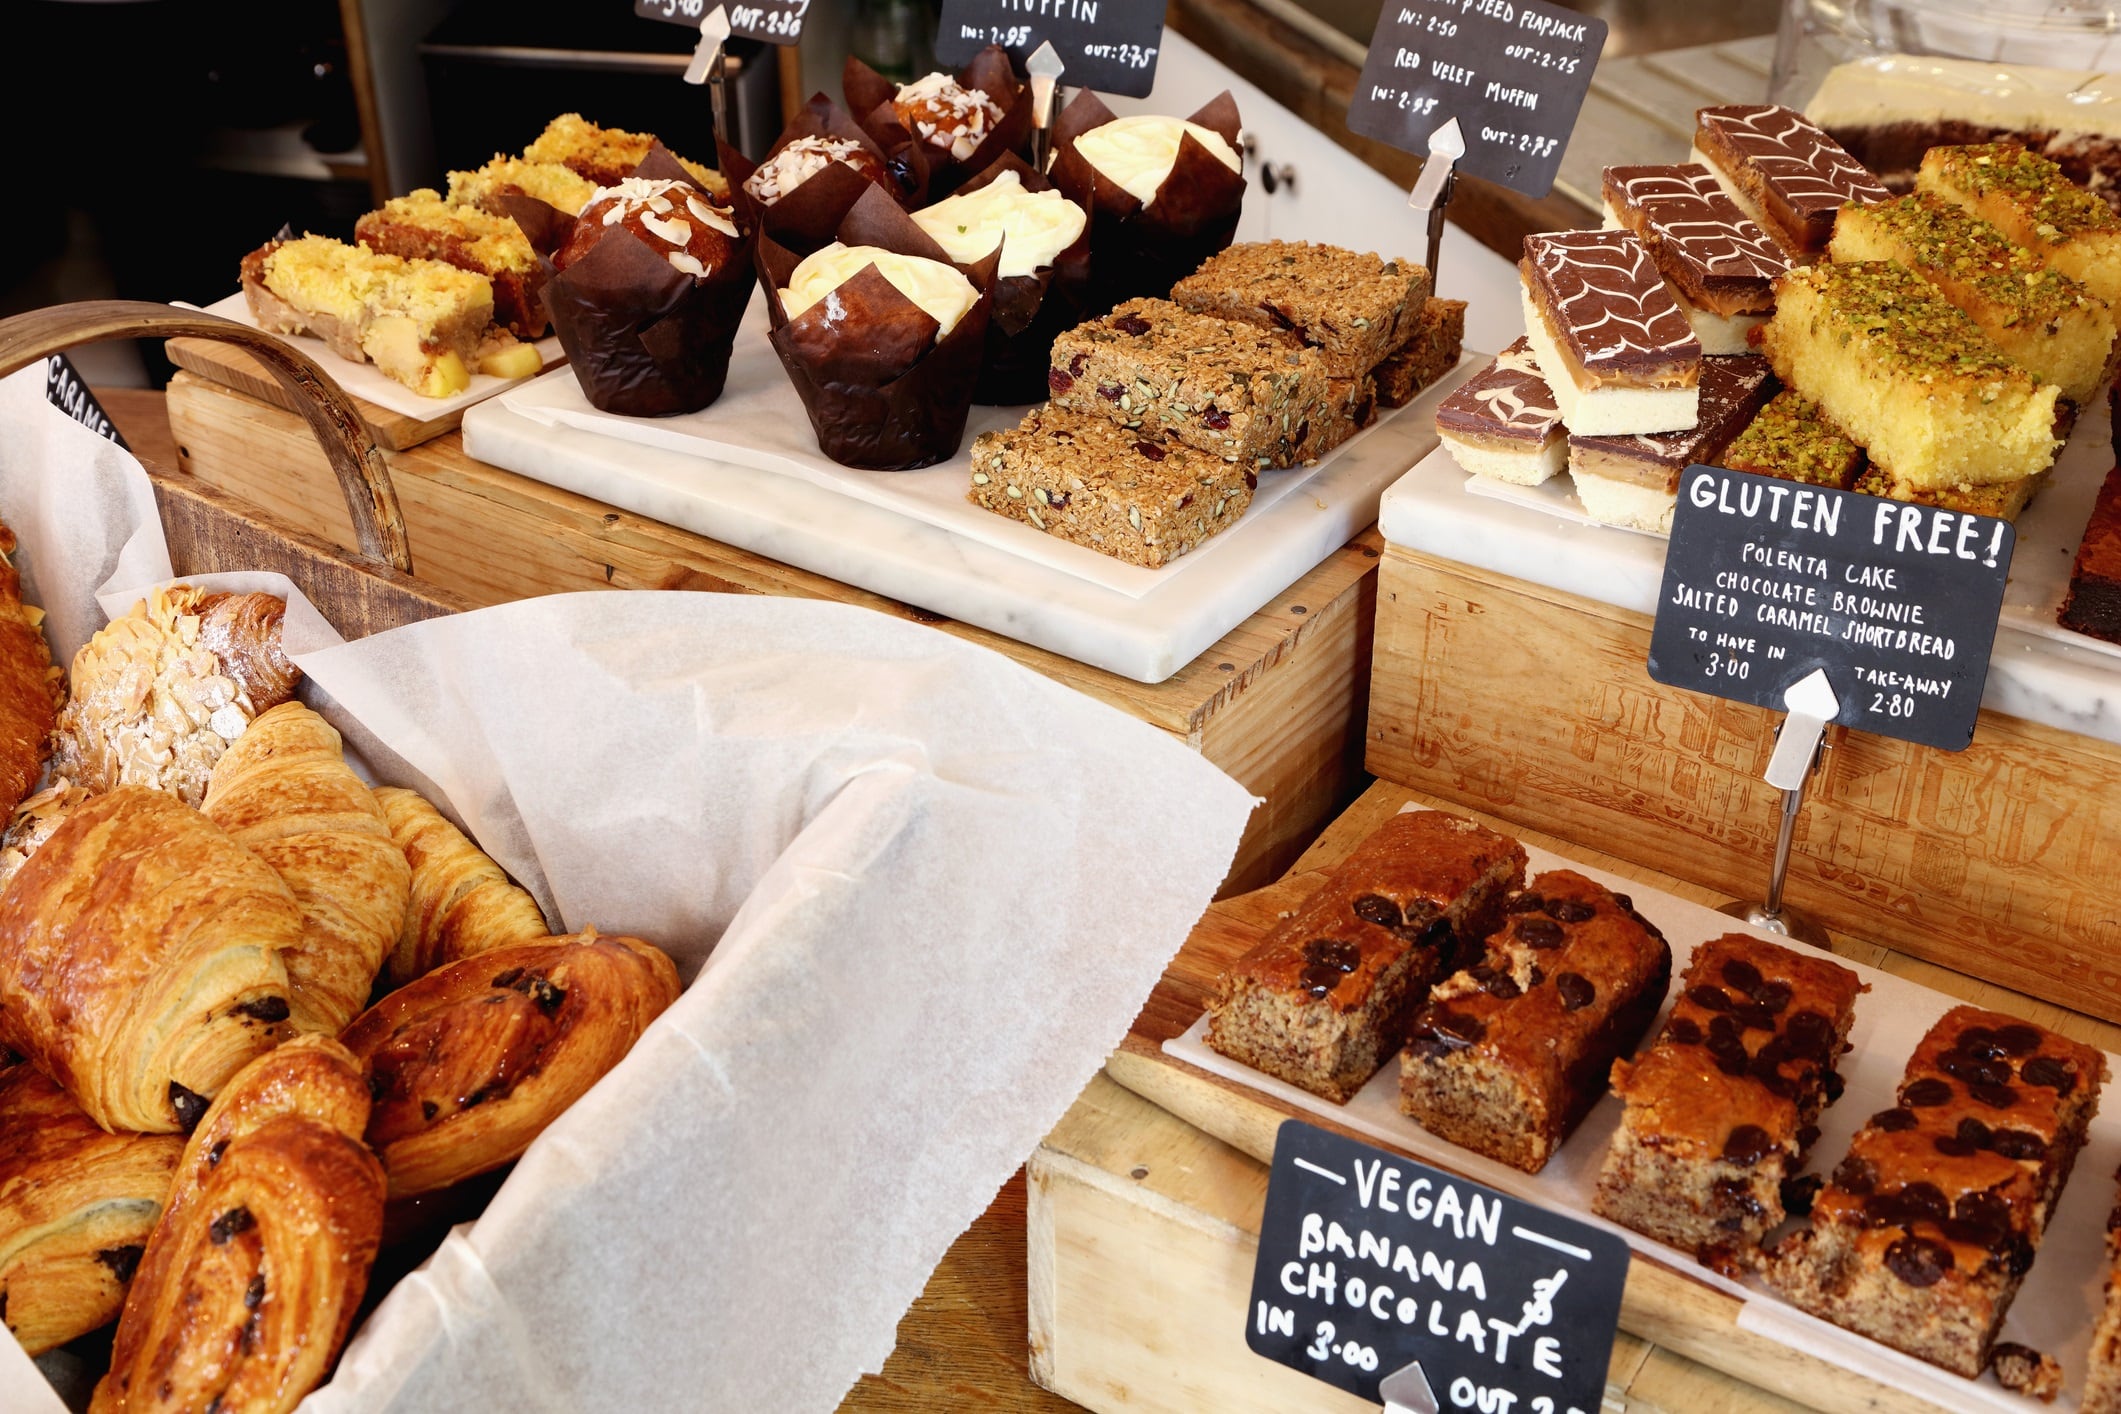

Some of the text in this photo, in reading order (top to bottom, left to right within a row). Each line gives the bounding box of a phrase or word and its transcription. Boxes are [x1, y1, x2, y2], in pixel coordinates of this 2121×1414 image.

[1519, 10, 1587, 42] FLAPJACK
[1394, 47, 1539, 111] RED VELET MUFFIN
[1690, 474, 2005, 568] GLUTEN FREE!
[1742, 543, 1898, 590] POLENTA CAKE
[1672, 583, 1955, 660] SALTED CARAMEL SHORTBREAD
[1716, 572, 1925, 625] CHOCOLATE BROWNIE
[1688, 627, 1786, 660] TO HAVE IN
[1855, 666, 1952, 699] TAKE-AWAY
[1815, 861, 1923, 918] VEGA
[1354, 1159, 1503, 1246] VEGAN
[1299, 1213, 1487, 1301] BANANA
[1256, 1300, 1296, 1337] IN
[1280, 1261, 1564, 1379] CHOCOLATE
[1449, 1376, 1518, 1414] OUT
